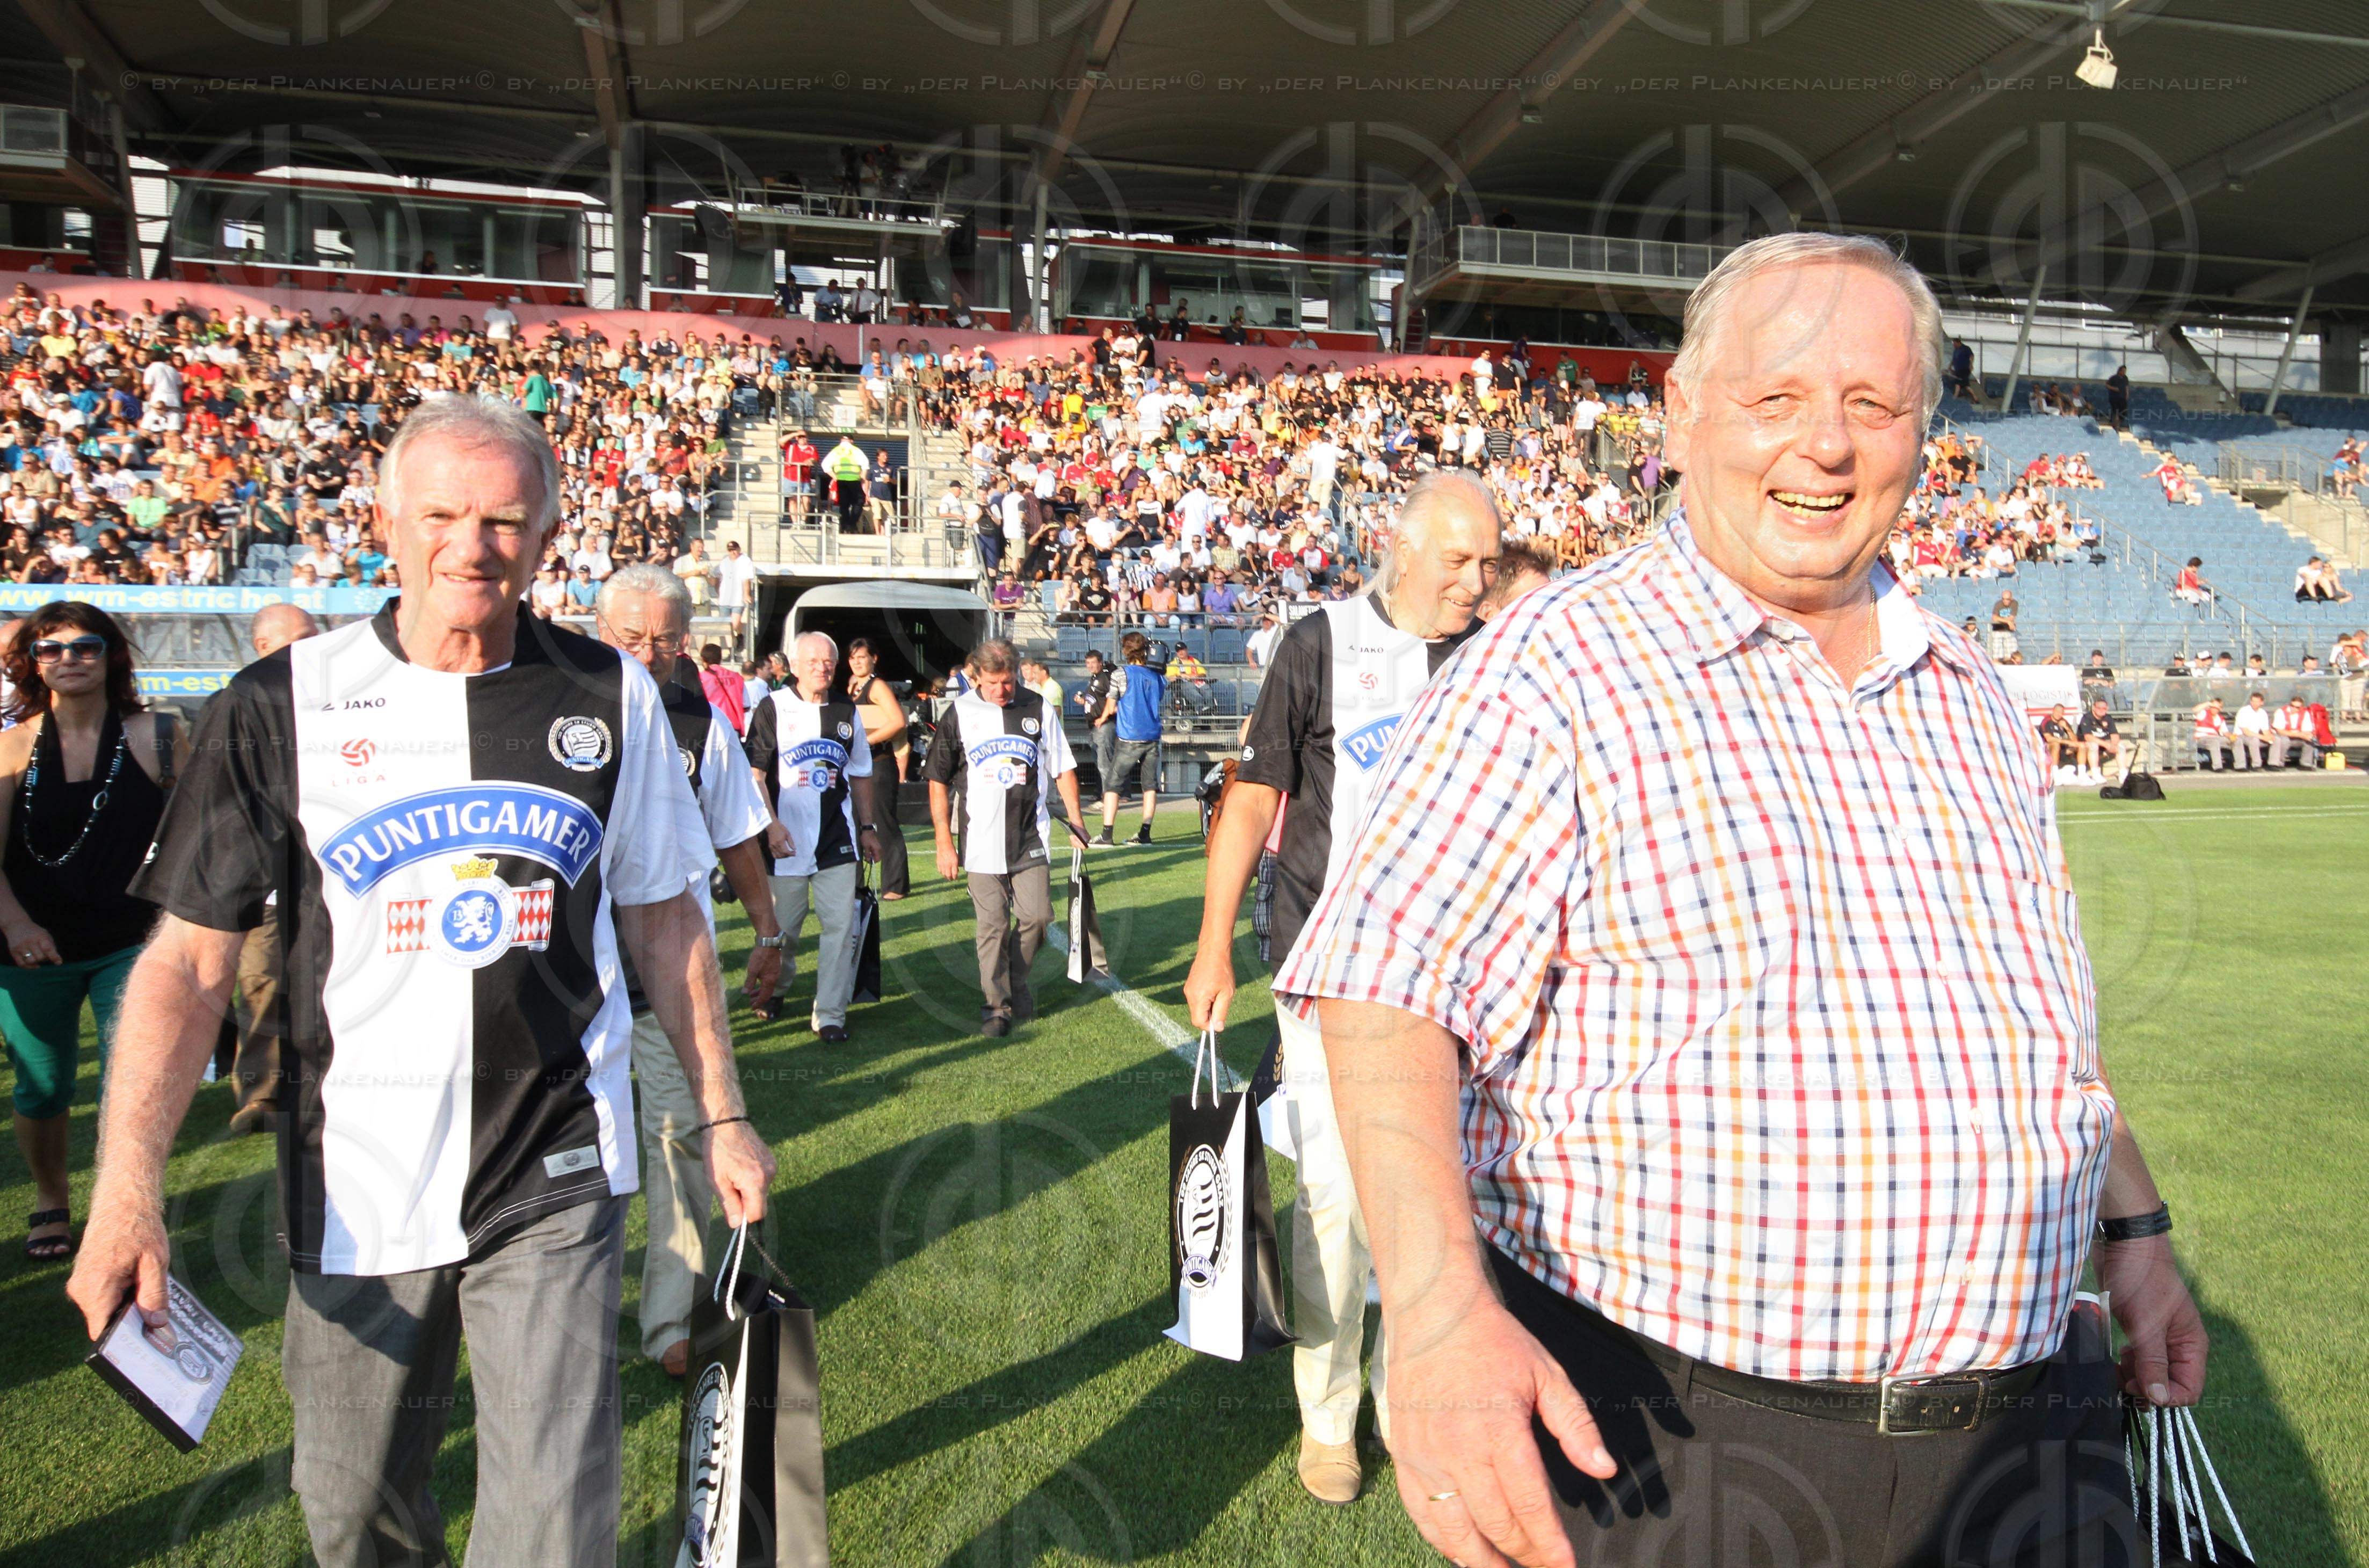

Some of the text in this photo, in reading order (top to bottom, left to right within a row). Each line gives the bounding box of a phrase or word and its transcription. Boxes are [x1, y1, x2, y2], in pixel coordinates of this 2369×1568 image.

[141, 674, 230, 692] m-est
[344, 698, 386, 710] JAKO
[784, 744, 846, 765] PUNTIGAM
[332, 774, 386, 787] LIGA
[330, 800, 591, 883] PUNTIGAMER
